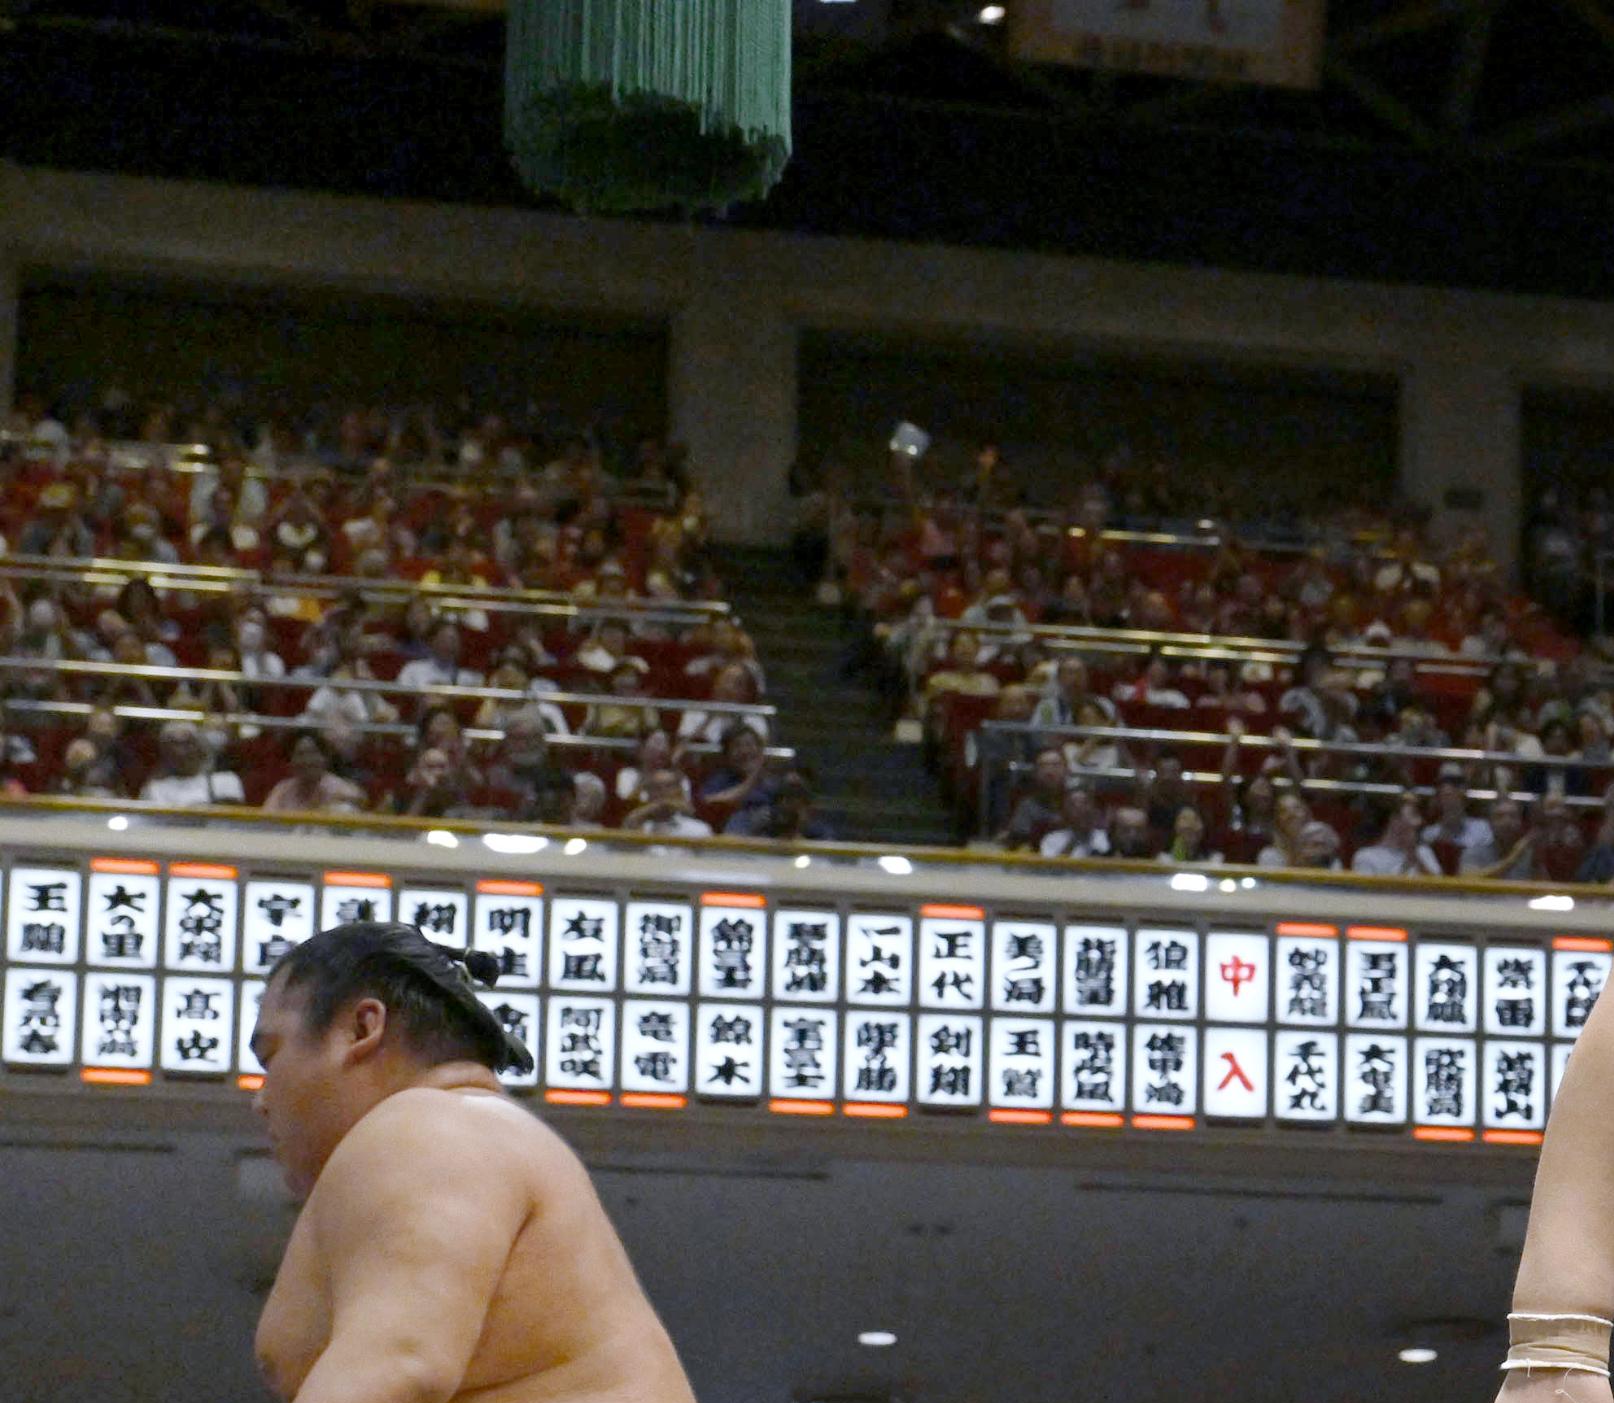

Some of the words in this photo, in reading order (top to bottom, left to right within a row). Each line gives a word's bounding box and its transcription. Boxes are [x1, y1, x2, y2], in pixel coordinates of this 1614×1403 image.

[103, 886, 145, 957] 大の里
[860, 927, 900, 994] 一山本
[932, 932, 972, 1000] 正代
[1146, 940, 1188, 1010] 狼雅
[1221, 957, 1256, 996] 中
[561, 1007, 602, 1079] 阿武咲
[709, 1015, 751, 1085] 錦木
[1217, 1053, 1254, 1092] 入
[1287, 1041, 1326, 1111] 千代丸
